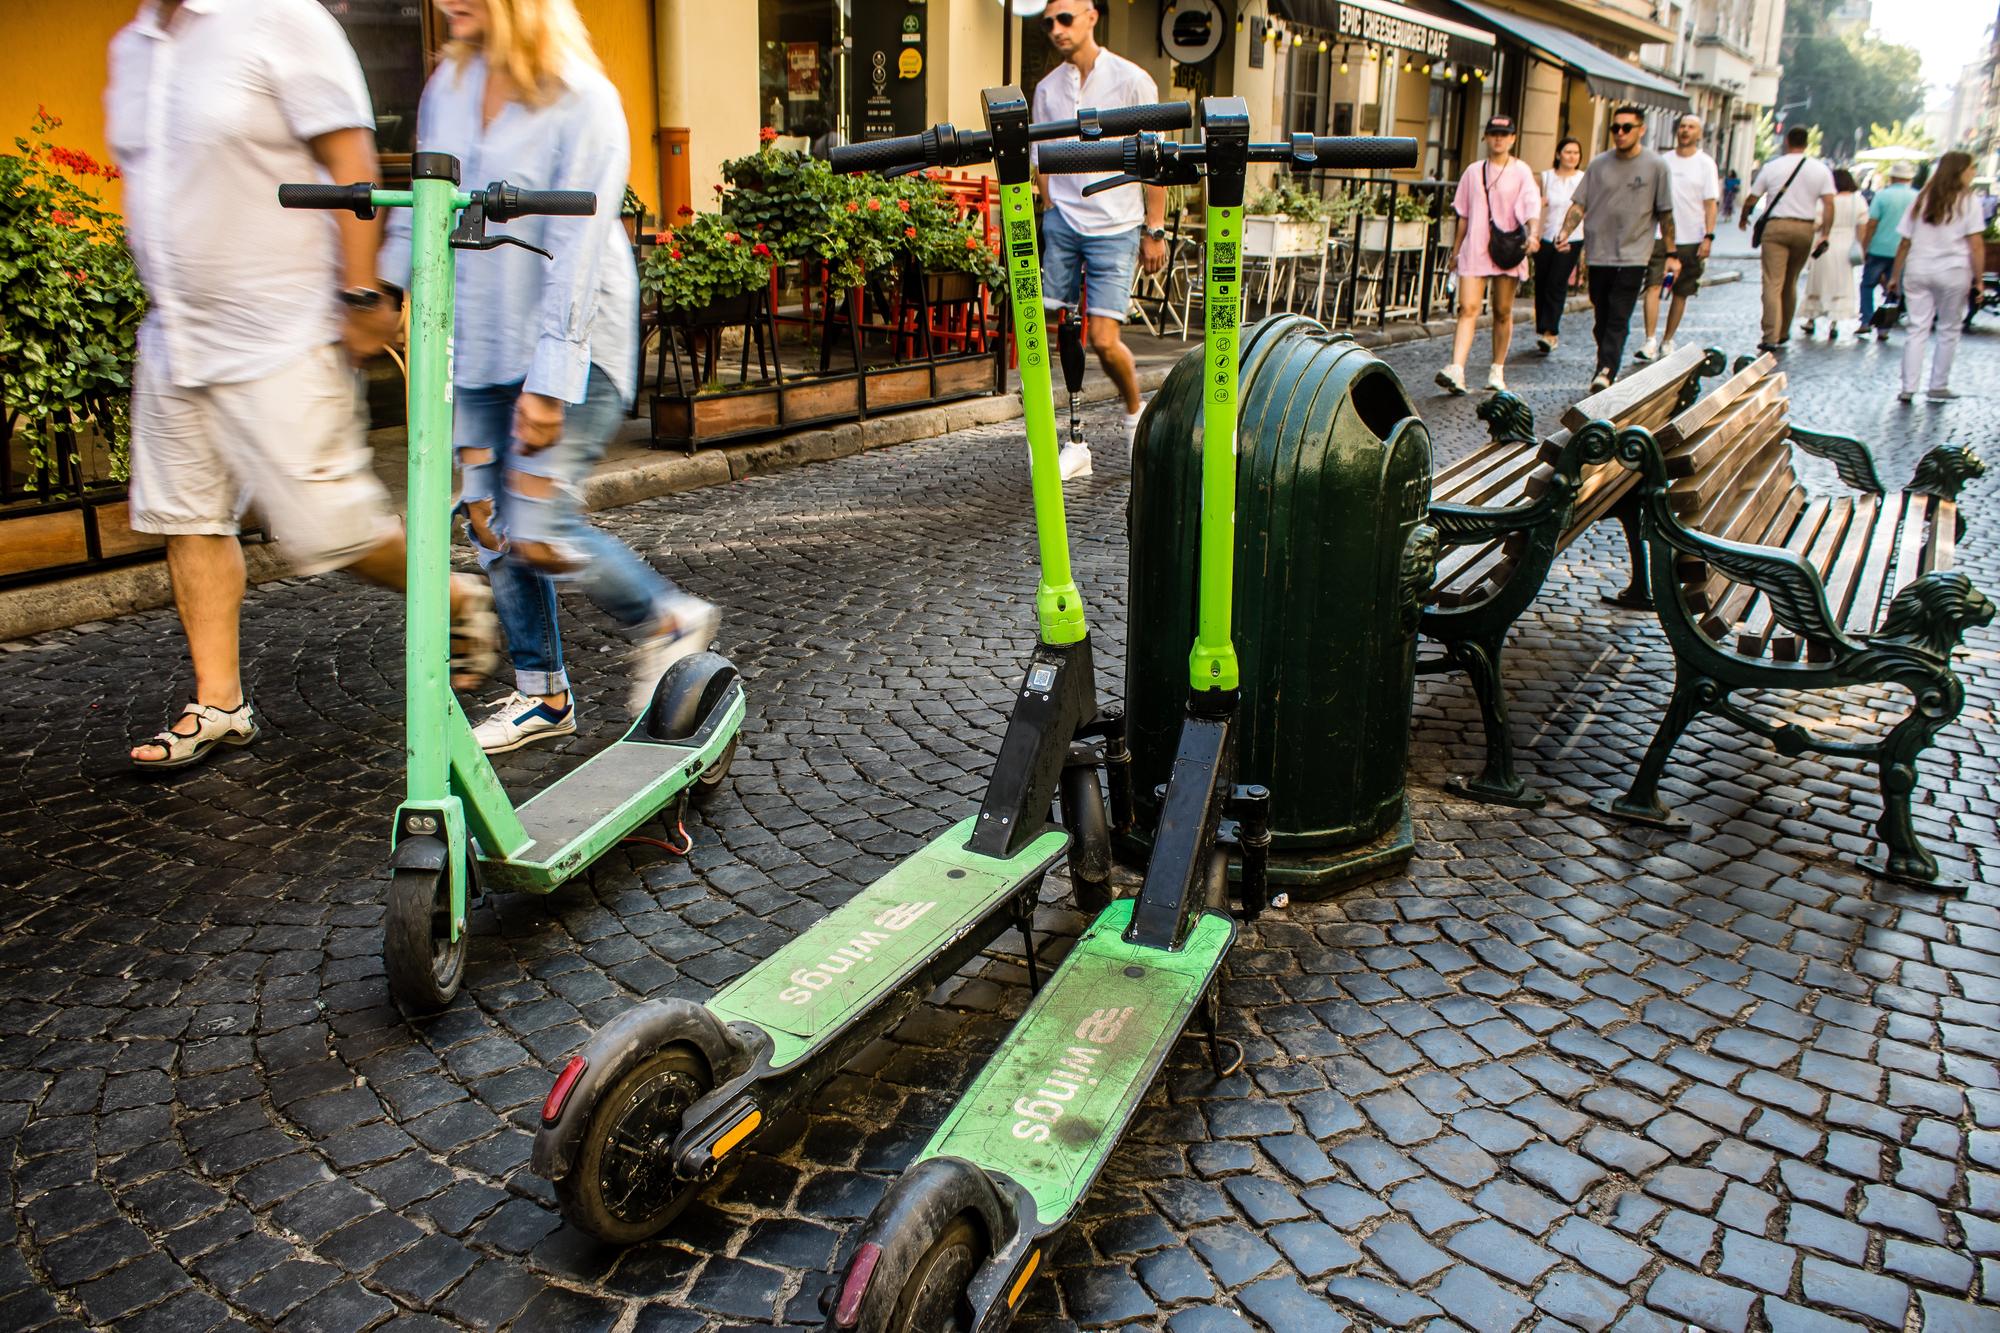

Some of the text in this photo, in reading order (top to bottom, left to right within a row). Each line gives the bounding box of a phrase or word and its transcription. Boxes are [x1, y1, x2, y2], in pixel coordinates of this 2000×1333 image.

[1339, 3, 1449, 58] EPIC CHEESEBURGER CAFE
[778, 930, 891, 1006] wings
[1012, 1046, 1102, 1144] wings
